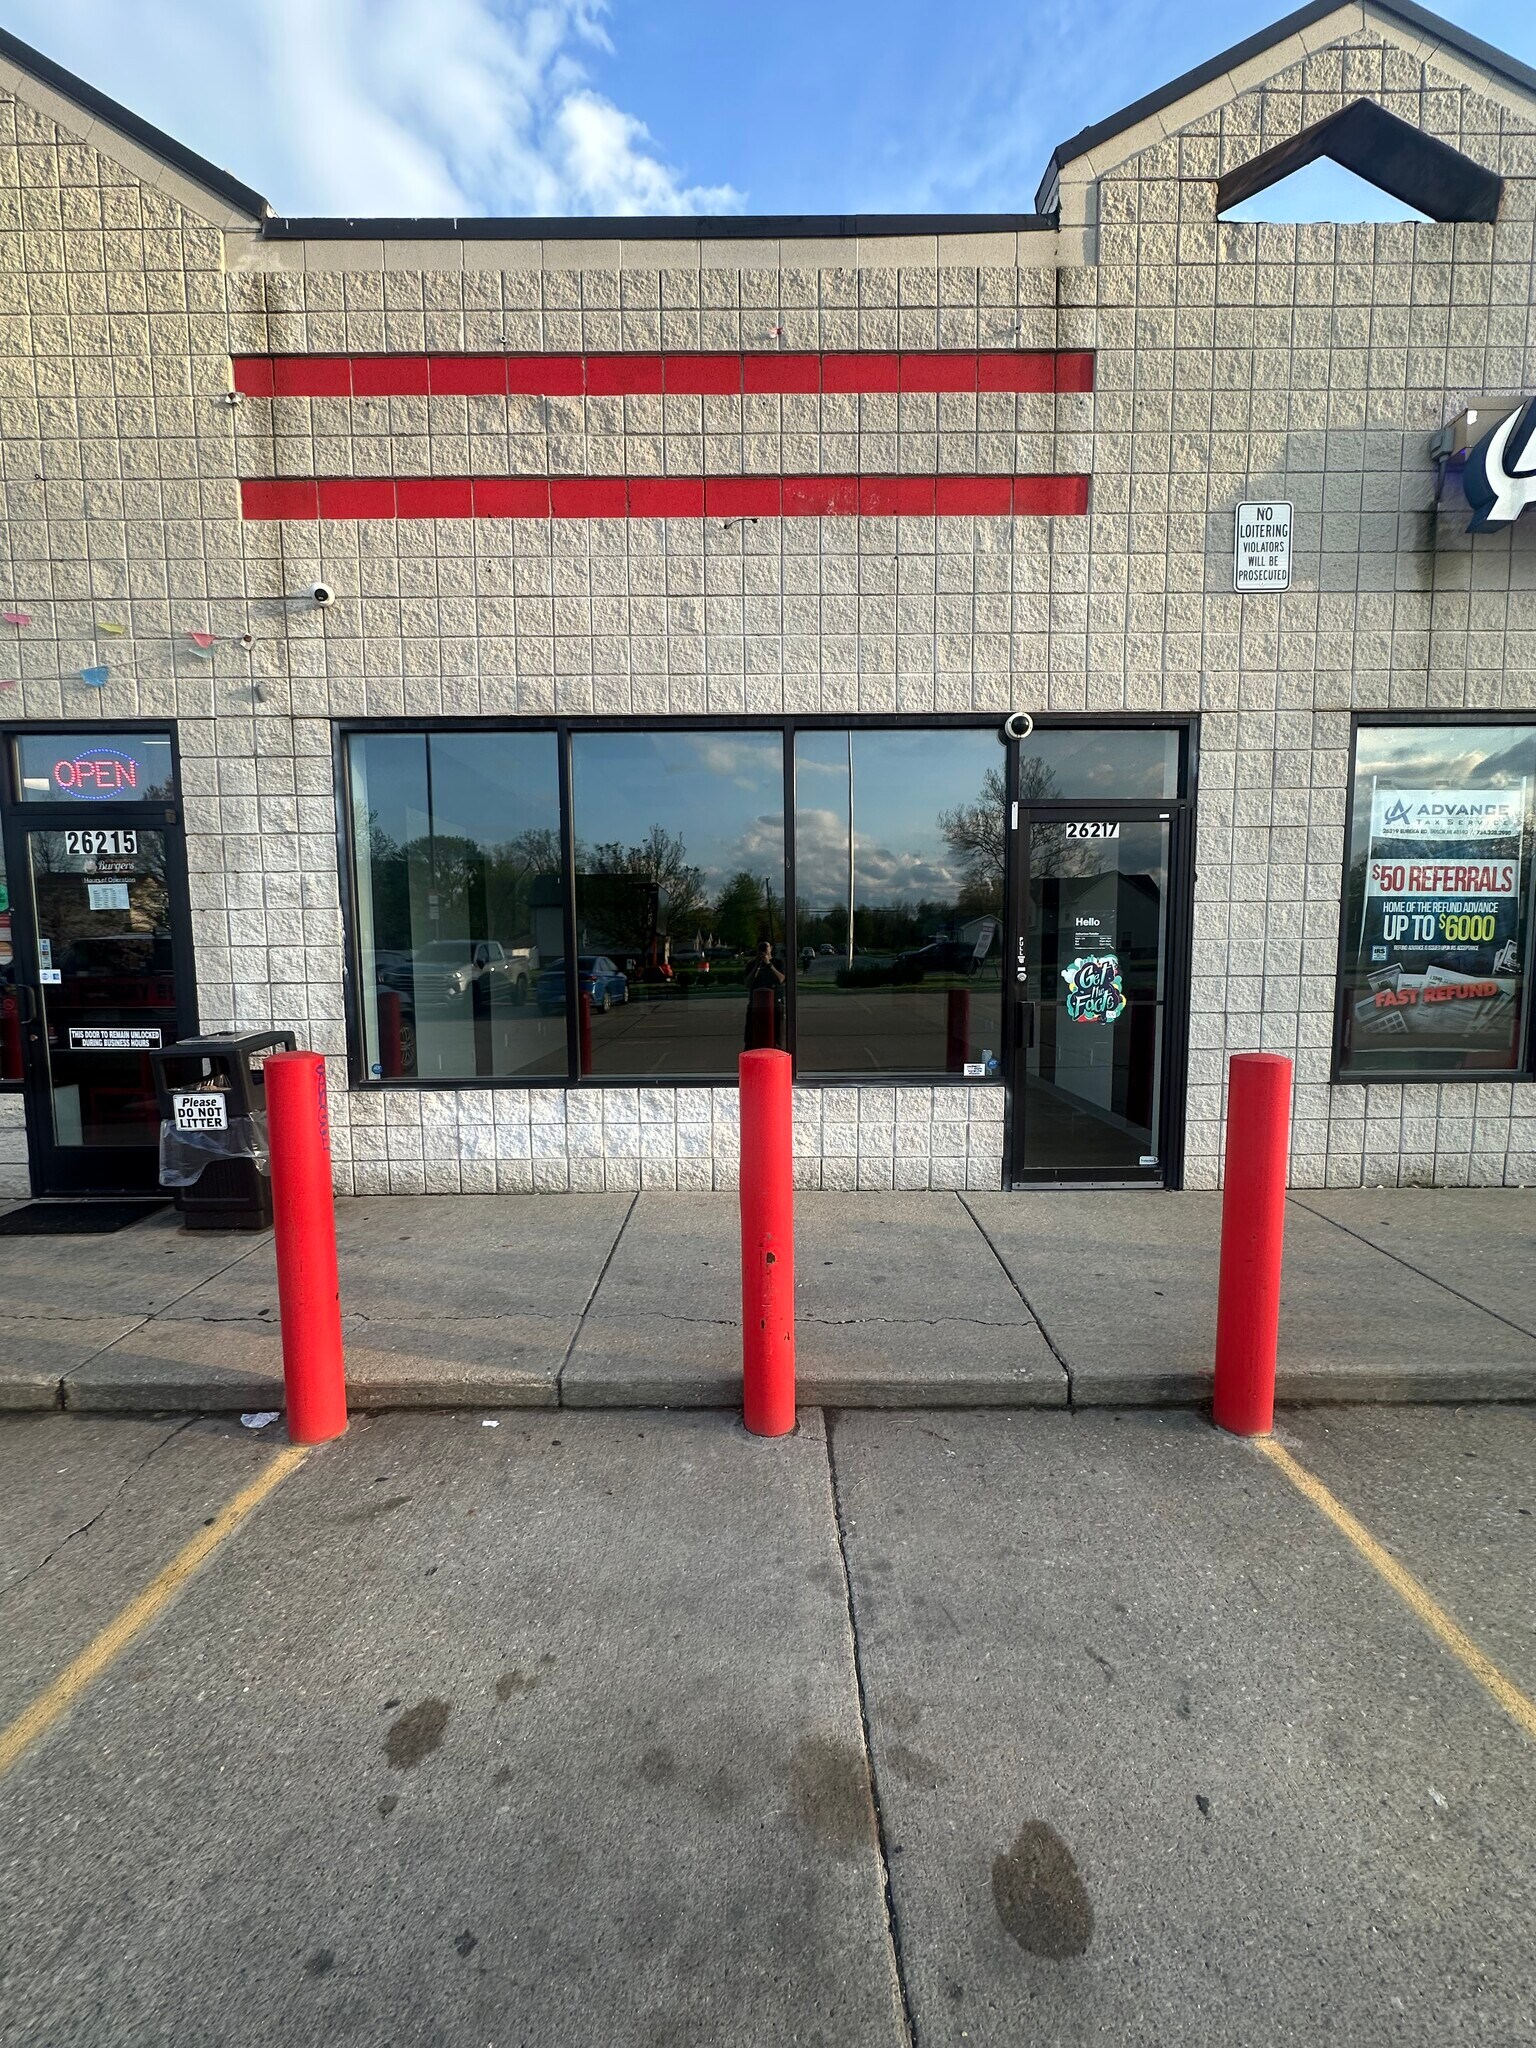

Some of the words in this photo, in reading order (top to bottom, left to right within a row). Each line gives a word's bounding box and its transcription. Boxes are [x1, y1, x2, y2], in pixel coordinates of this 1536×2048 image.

[1256, 506, 1273, 521] NO
[1240, 524, 1288, 538] LOITERING
[1243, 541, 1284, 553] VIOLATORS
[1248, 555, 1265, 567] WILL
[1269, 555, 1279, 567] BE
[1239, 569, 1287, 581] PROSECUTED
[54, 760, 136, 788] OPEN
[1417, 804, 1510, 816] ADVANCE
[1447, 818, 1509, 826] SERVICE
[1067, 822, 1118, 838] 26217
[67, 830, 135, 854] 26215
[98, 860, 135, 873] Burgers
[1372, 863, 1405, 892] $50
[1408, 865, 1513, 892] REFERRALS
[1383, 902, 1405, 913] HOME
[1407, 902, 1417, 913] OF
[1417, 902, 1432, 913] THE
[1433, 902, 1462, 913] REFUND
[1463, 902, 1499, 913] ADVANCE
[1075, 917, 1101, 927] Hello
[1383, 915, 1409, 941] UP
[1412, 915, 1436, 941] TO
[1438, 913, 1496, 941] $6000
[1079, 963, 1112, 988] Get
[1375, 988, 1419, 1008] FAST
[1423, 981, 1498, 1002] REFUND
[1074, 989, 1114, 1018] Facts
[71, 1030, 84, 1039] THIS
[85, 1030, 100, 1039] DOOR
[101, 1031, 109, 1039] TO
[109, 1031, 130, 1039] REMAIN
[130, 1031, 160, 1039] UNLOCKED
[82, 1039, 103, 1047] DURING
[103, 1039, 130, 1047] BUSINESS
[130, 1039, 150, 1047] HOURS
[182, 1097, 217, 1108] Please
[178, 1108, 194, 1118] DO
[198, 1107, 222, 1117] NOT
[179, 1118, 222, 1128] LITTER
